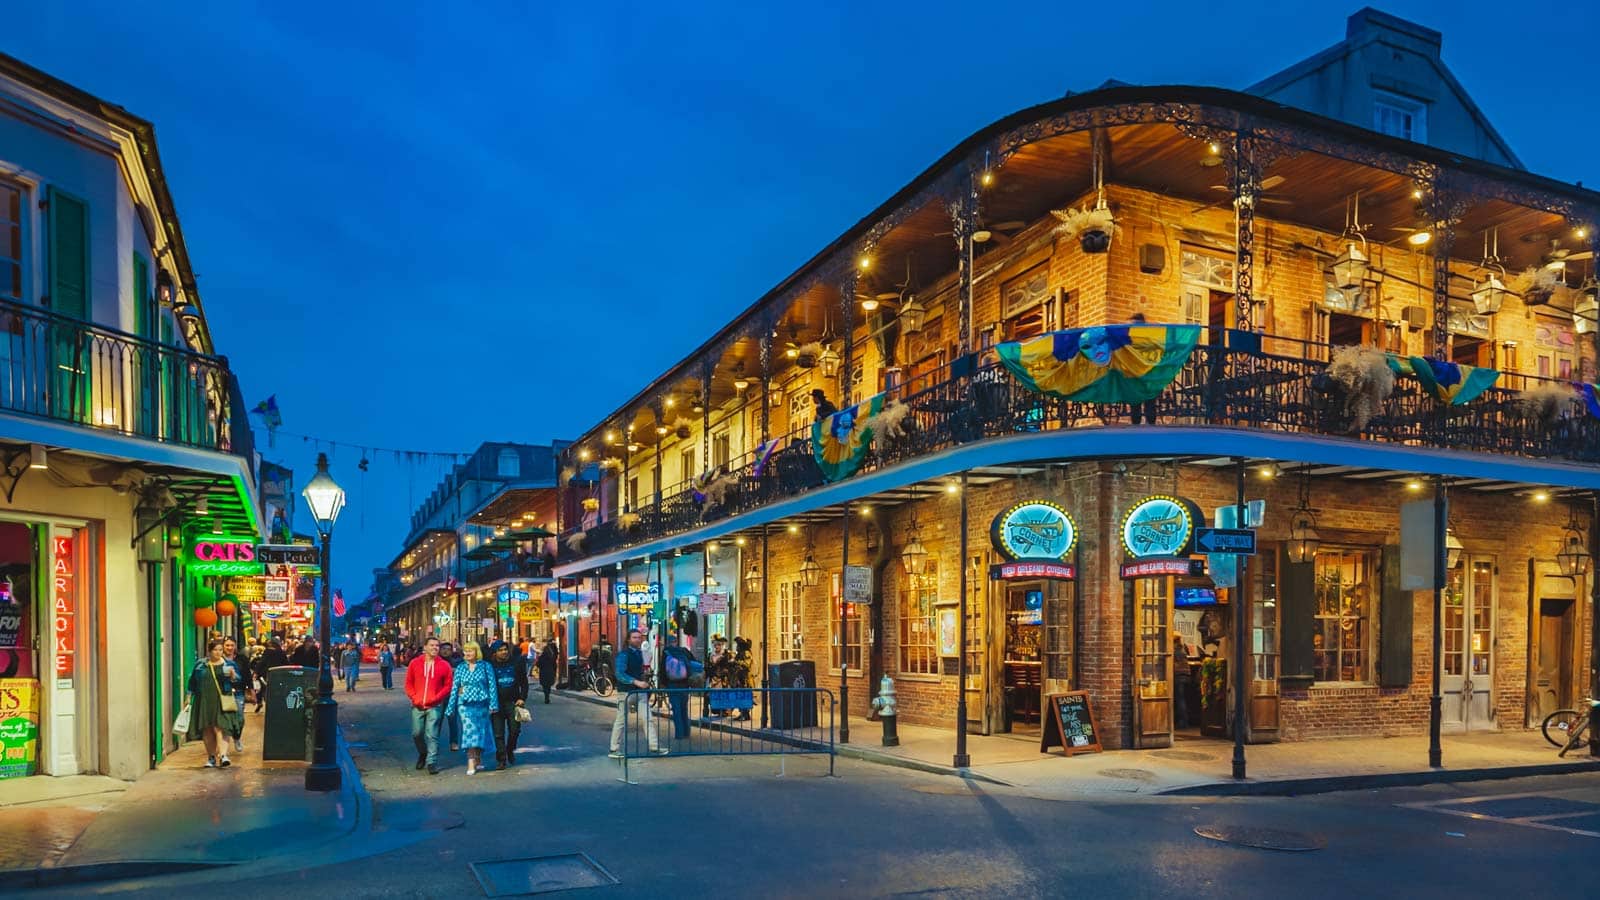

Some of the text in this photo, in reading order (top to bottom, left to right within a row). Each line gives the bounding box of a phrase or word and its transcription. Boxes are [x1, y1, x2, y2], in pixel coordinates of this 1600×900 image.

[1019, 528, 1052, 547] CORNET
[1140, 527, 1172, 545] CORNET
[1215, 536, 1251, 547] ONE WAY
[1002, 564, 1071, 576] NEW ORLEANS CUISINE
[1125, 562, 1189, 575] NEW ORLEANS CUISINE
[54, 539, 67, 671] KARAOKE
